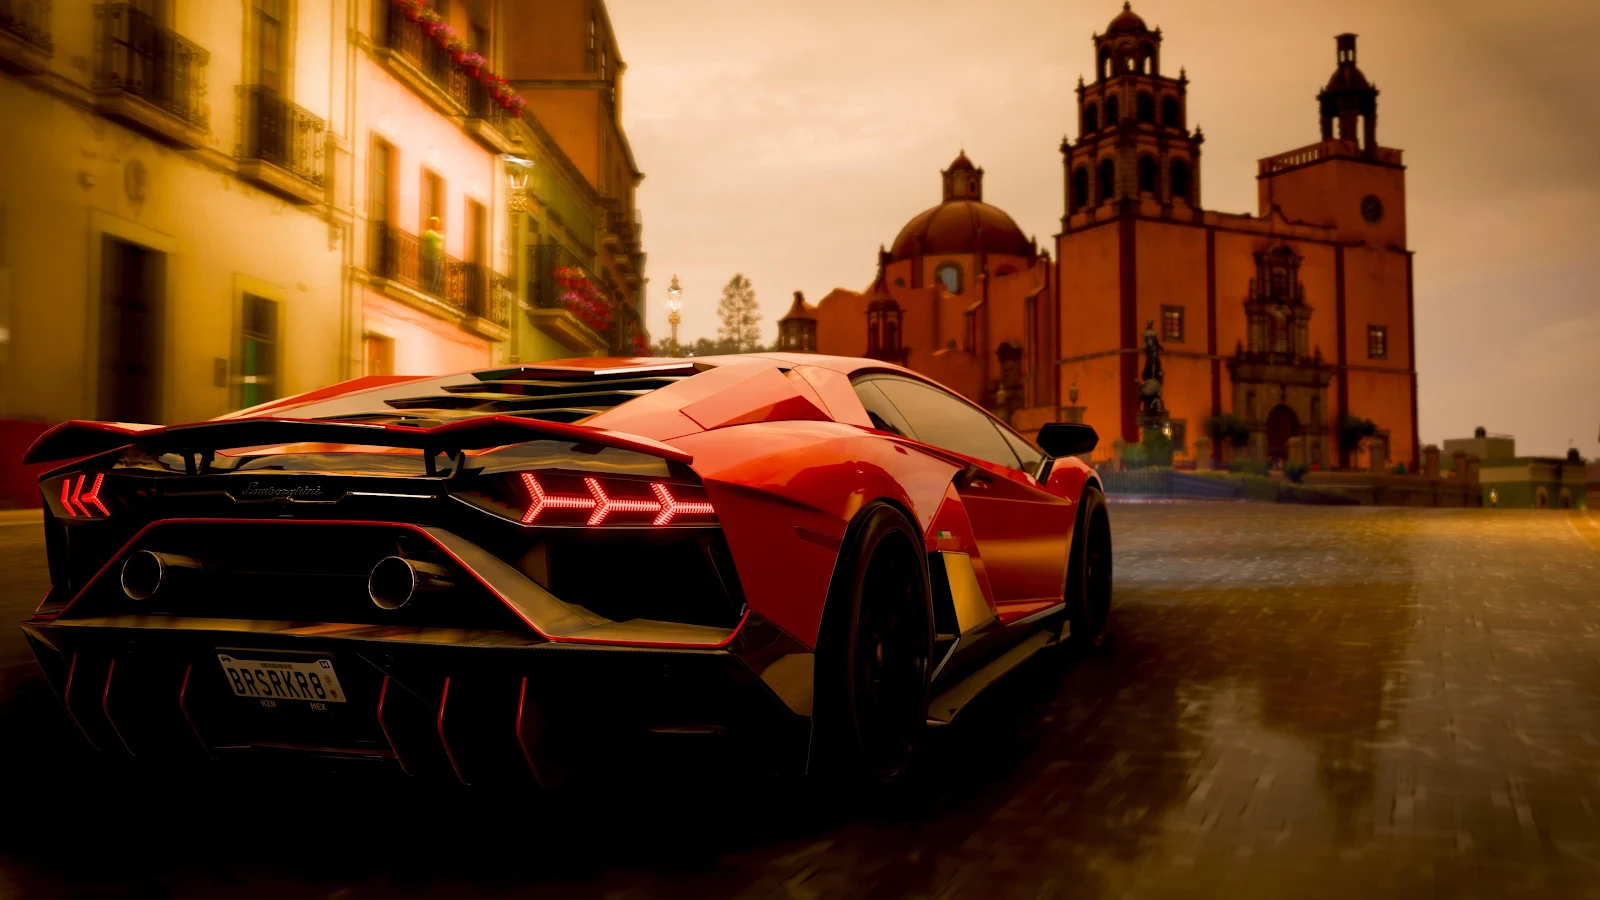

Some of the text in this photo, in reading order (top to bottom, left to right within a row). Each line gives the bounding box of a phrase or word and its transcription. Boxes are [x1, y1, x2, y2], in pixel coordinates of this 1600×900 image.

[241, 481, 322, 496] Lamborghini
[227, 667, 327, 700] BRSRKR8
[309, 702, 328, 711] MEX
